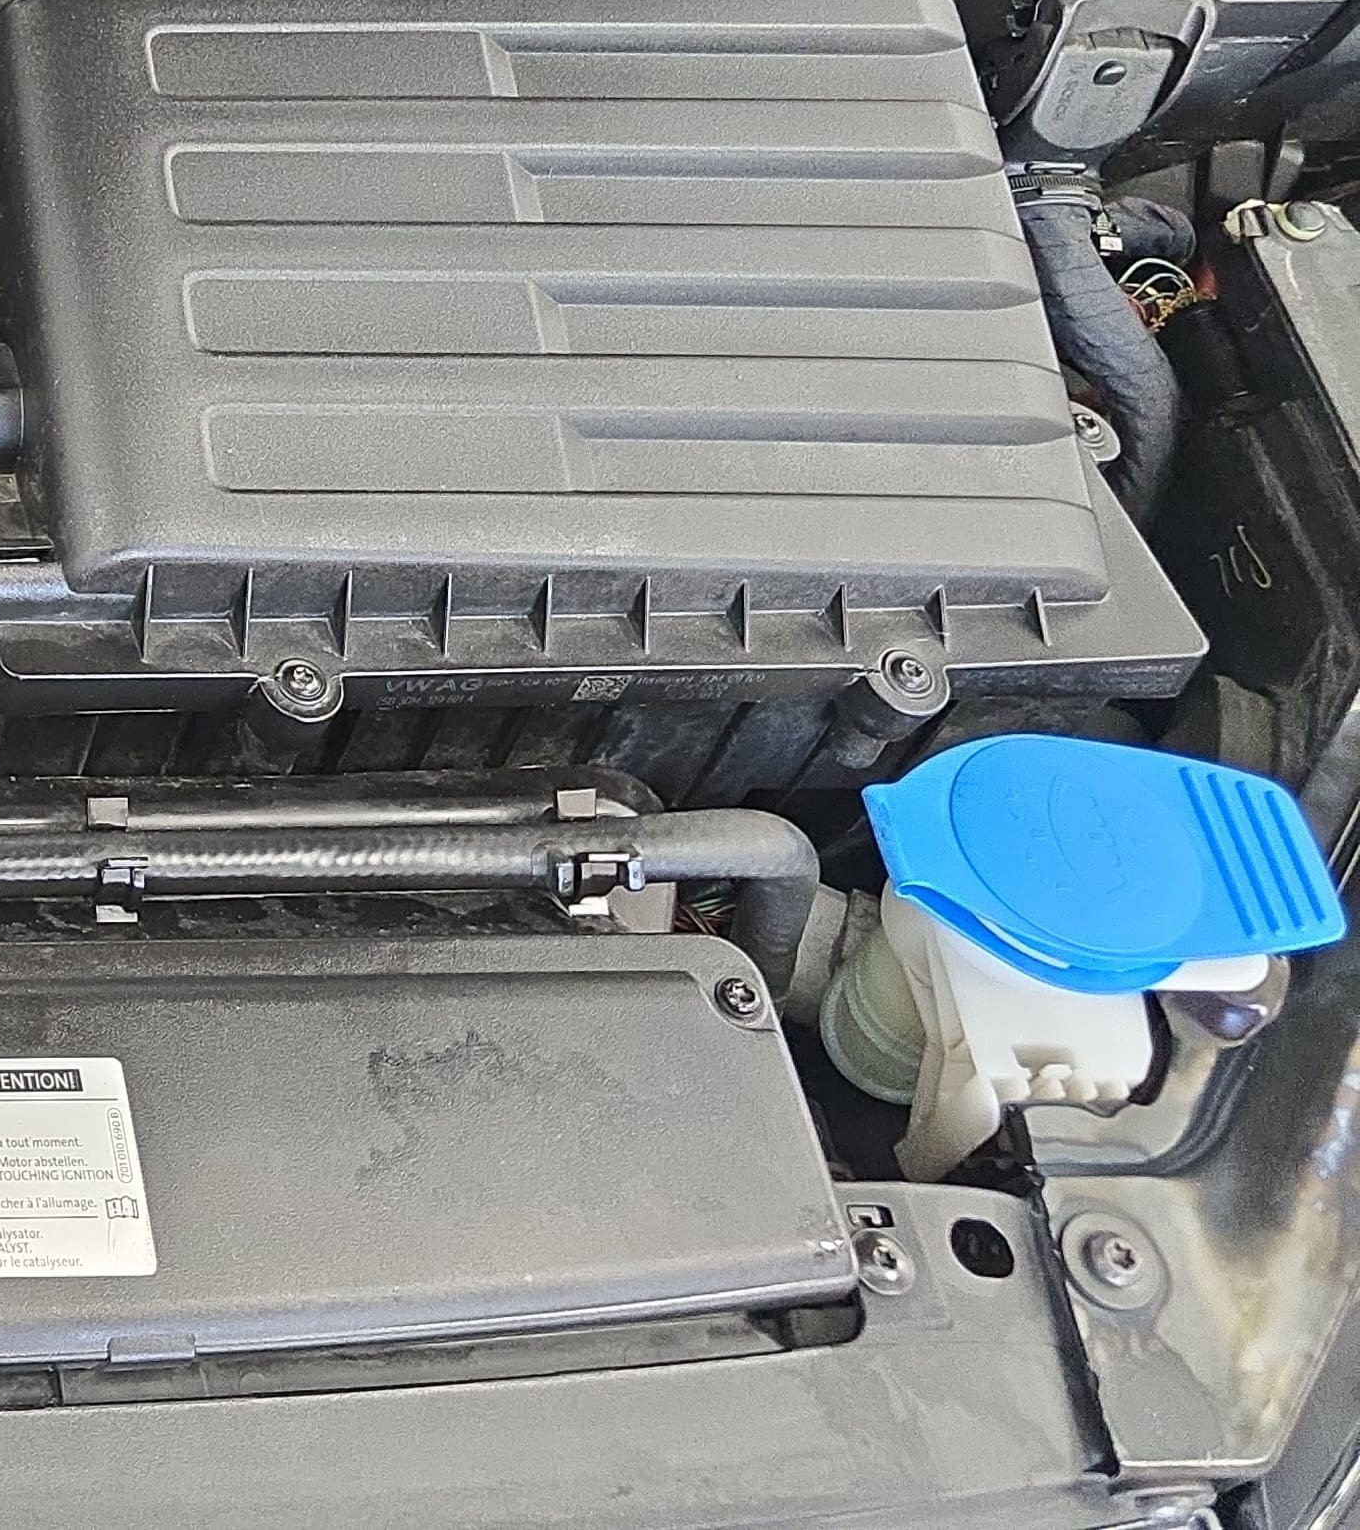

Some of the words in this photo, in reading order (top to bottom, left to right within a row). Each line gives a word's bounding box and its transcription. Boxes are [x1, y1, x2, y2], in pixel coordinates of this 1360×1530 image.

[386, 679, 431, 692] VW
[436, 678, 480, 692] AG
[6, 1137, 30, 1148] tout
[32, 1137, 83, 1148] moment.
[35, 1156, 88, 1167] abstellen.
[62, 1169, 114, 1181] IGNITION
